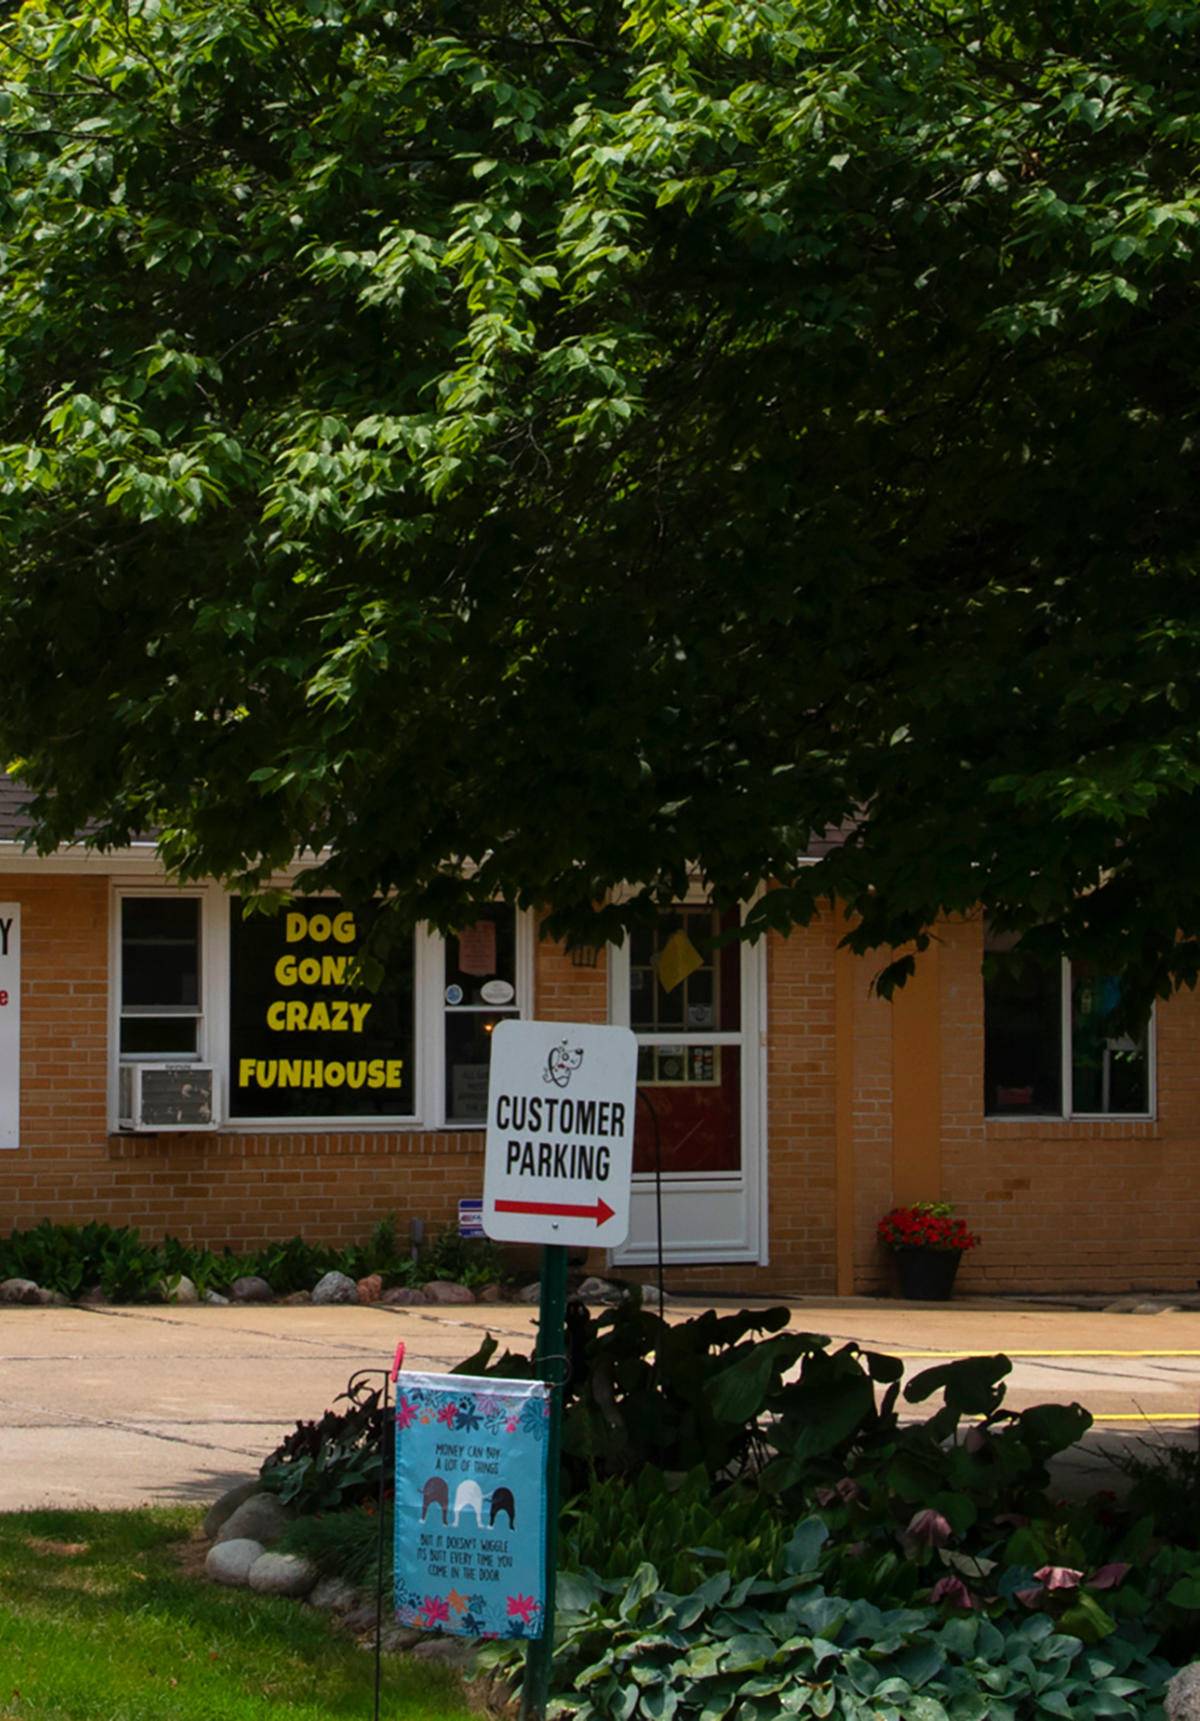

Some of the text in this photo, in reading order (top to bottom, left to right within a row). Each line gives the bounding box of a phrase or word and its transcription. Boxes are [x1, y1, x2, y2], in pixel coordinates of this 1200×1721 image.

[285, 911, 356, 944] DOG
[266, 1000, 372, 1033] CRAZY
[238, 1058, 403, 1089] FUNHOUSE
[496, 1094, 626, 1137] CUSTOMER
[506, 1140, 611, 1182] PARKING
[435, 1443, 500, 1460] MONEY CAN BUY
[435, 1457, 498, 1474] A LOT OF THINGS
[420, 1533, 508, 1553] BUT IT DOESN'T WIGGLE
[429, 1548, 446, 1562] BUTT
[450, 1551, 473, 1565] EVERY
[477, 1552, 494, 1567] TIME
[498, 1554, 513, 1568] YOU
[428, 1564, 500, 1582] COME IN THE DOOR
